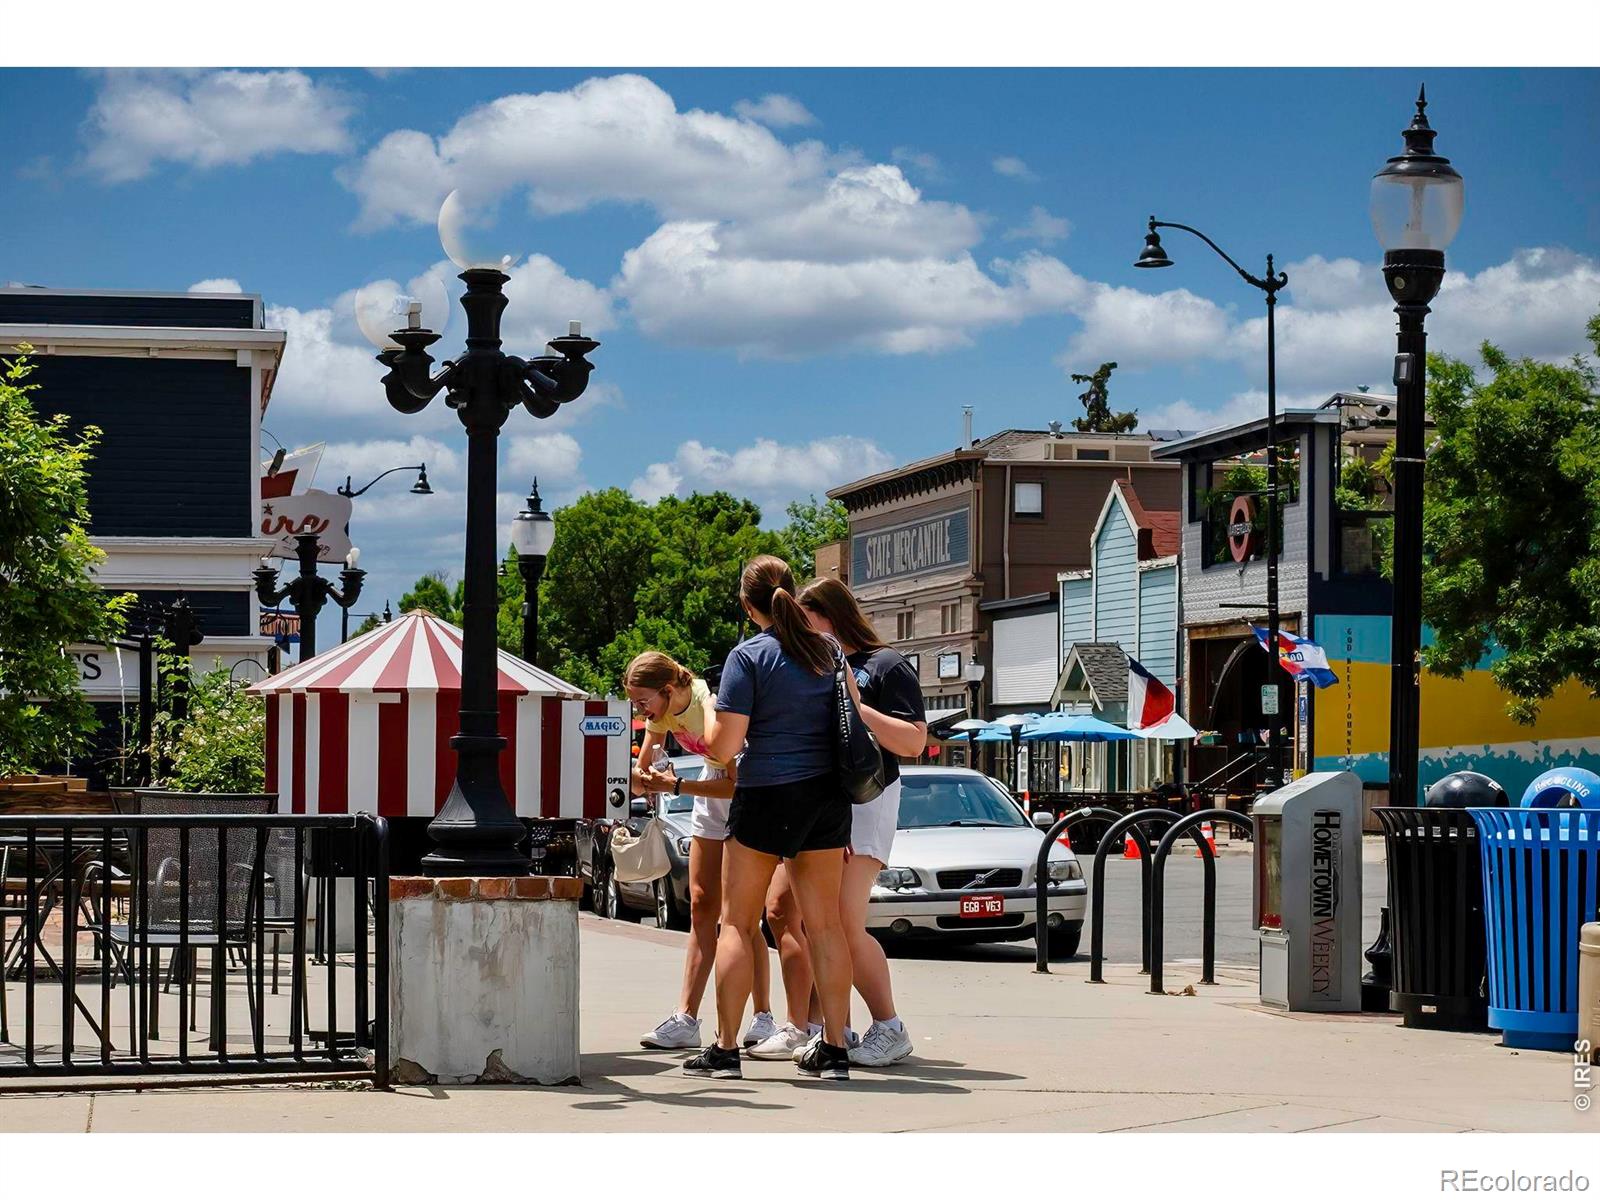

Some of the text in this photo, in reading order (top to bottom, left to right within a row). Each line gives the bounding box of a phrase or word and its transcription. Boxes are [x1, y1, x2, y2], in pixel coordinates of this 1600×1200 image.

[866, 518, 951, 579] STATE MERCANTILE
[585, 721, 620, 732] MAGIC
[607, 777, 628, 785] OPEN
[1312, 811, 1341, 997] HOMETOWN WEEKLY
